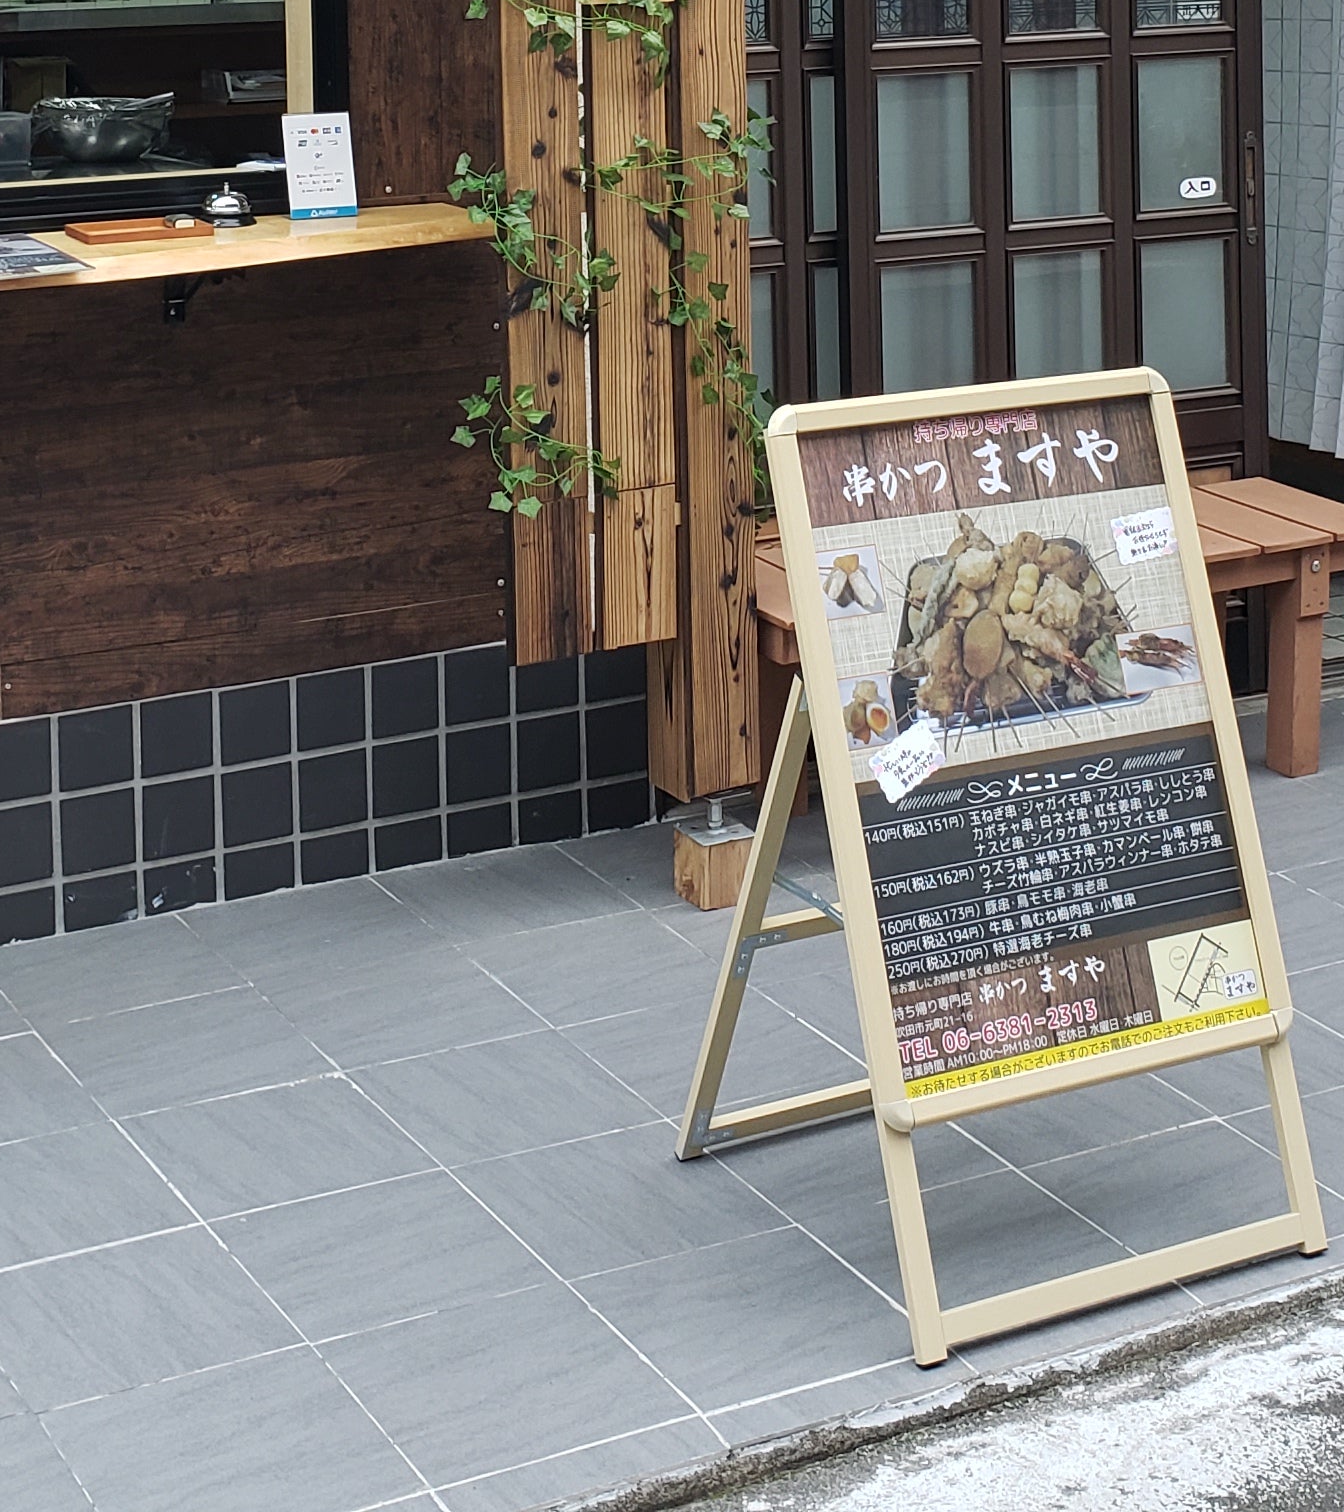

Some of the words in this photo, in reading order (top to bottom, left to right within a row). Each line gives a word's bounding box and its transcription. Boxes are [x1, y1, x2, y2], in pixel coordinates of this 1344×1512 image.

[1185, 180, 1210, 194] 入口
[913, 408, 1038, 442] 持ち帰り専門店
[842, 460, 946, 507] 串かつ
[972, 428, 1119, 495] ますや
[1007, 771, 1077, 796] メニュー
[892, 992, 974, 1021] 持ち帰り専門店
[977, 977, 1027, 1004] 串かつ
[1038, 956, 1106, 993] ますや
[899, 1035, 939, 1064] TEL
[941, 997, 1098, 1055] 06-6381-2313
[902, 1057, 946, 1080] 営業時間
[1057, 1024, 1088, 1045] 定休日
[1089, 1017, 1120, 1038] 水曜日
[1124, 1009, 1154, 1031] 木曜日
